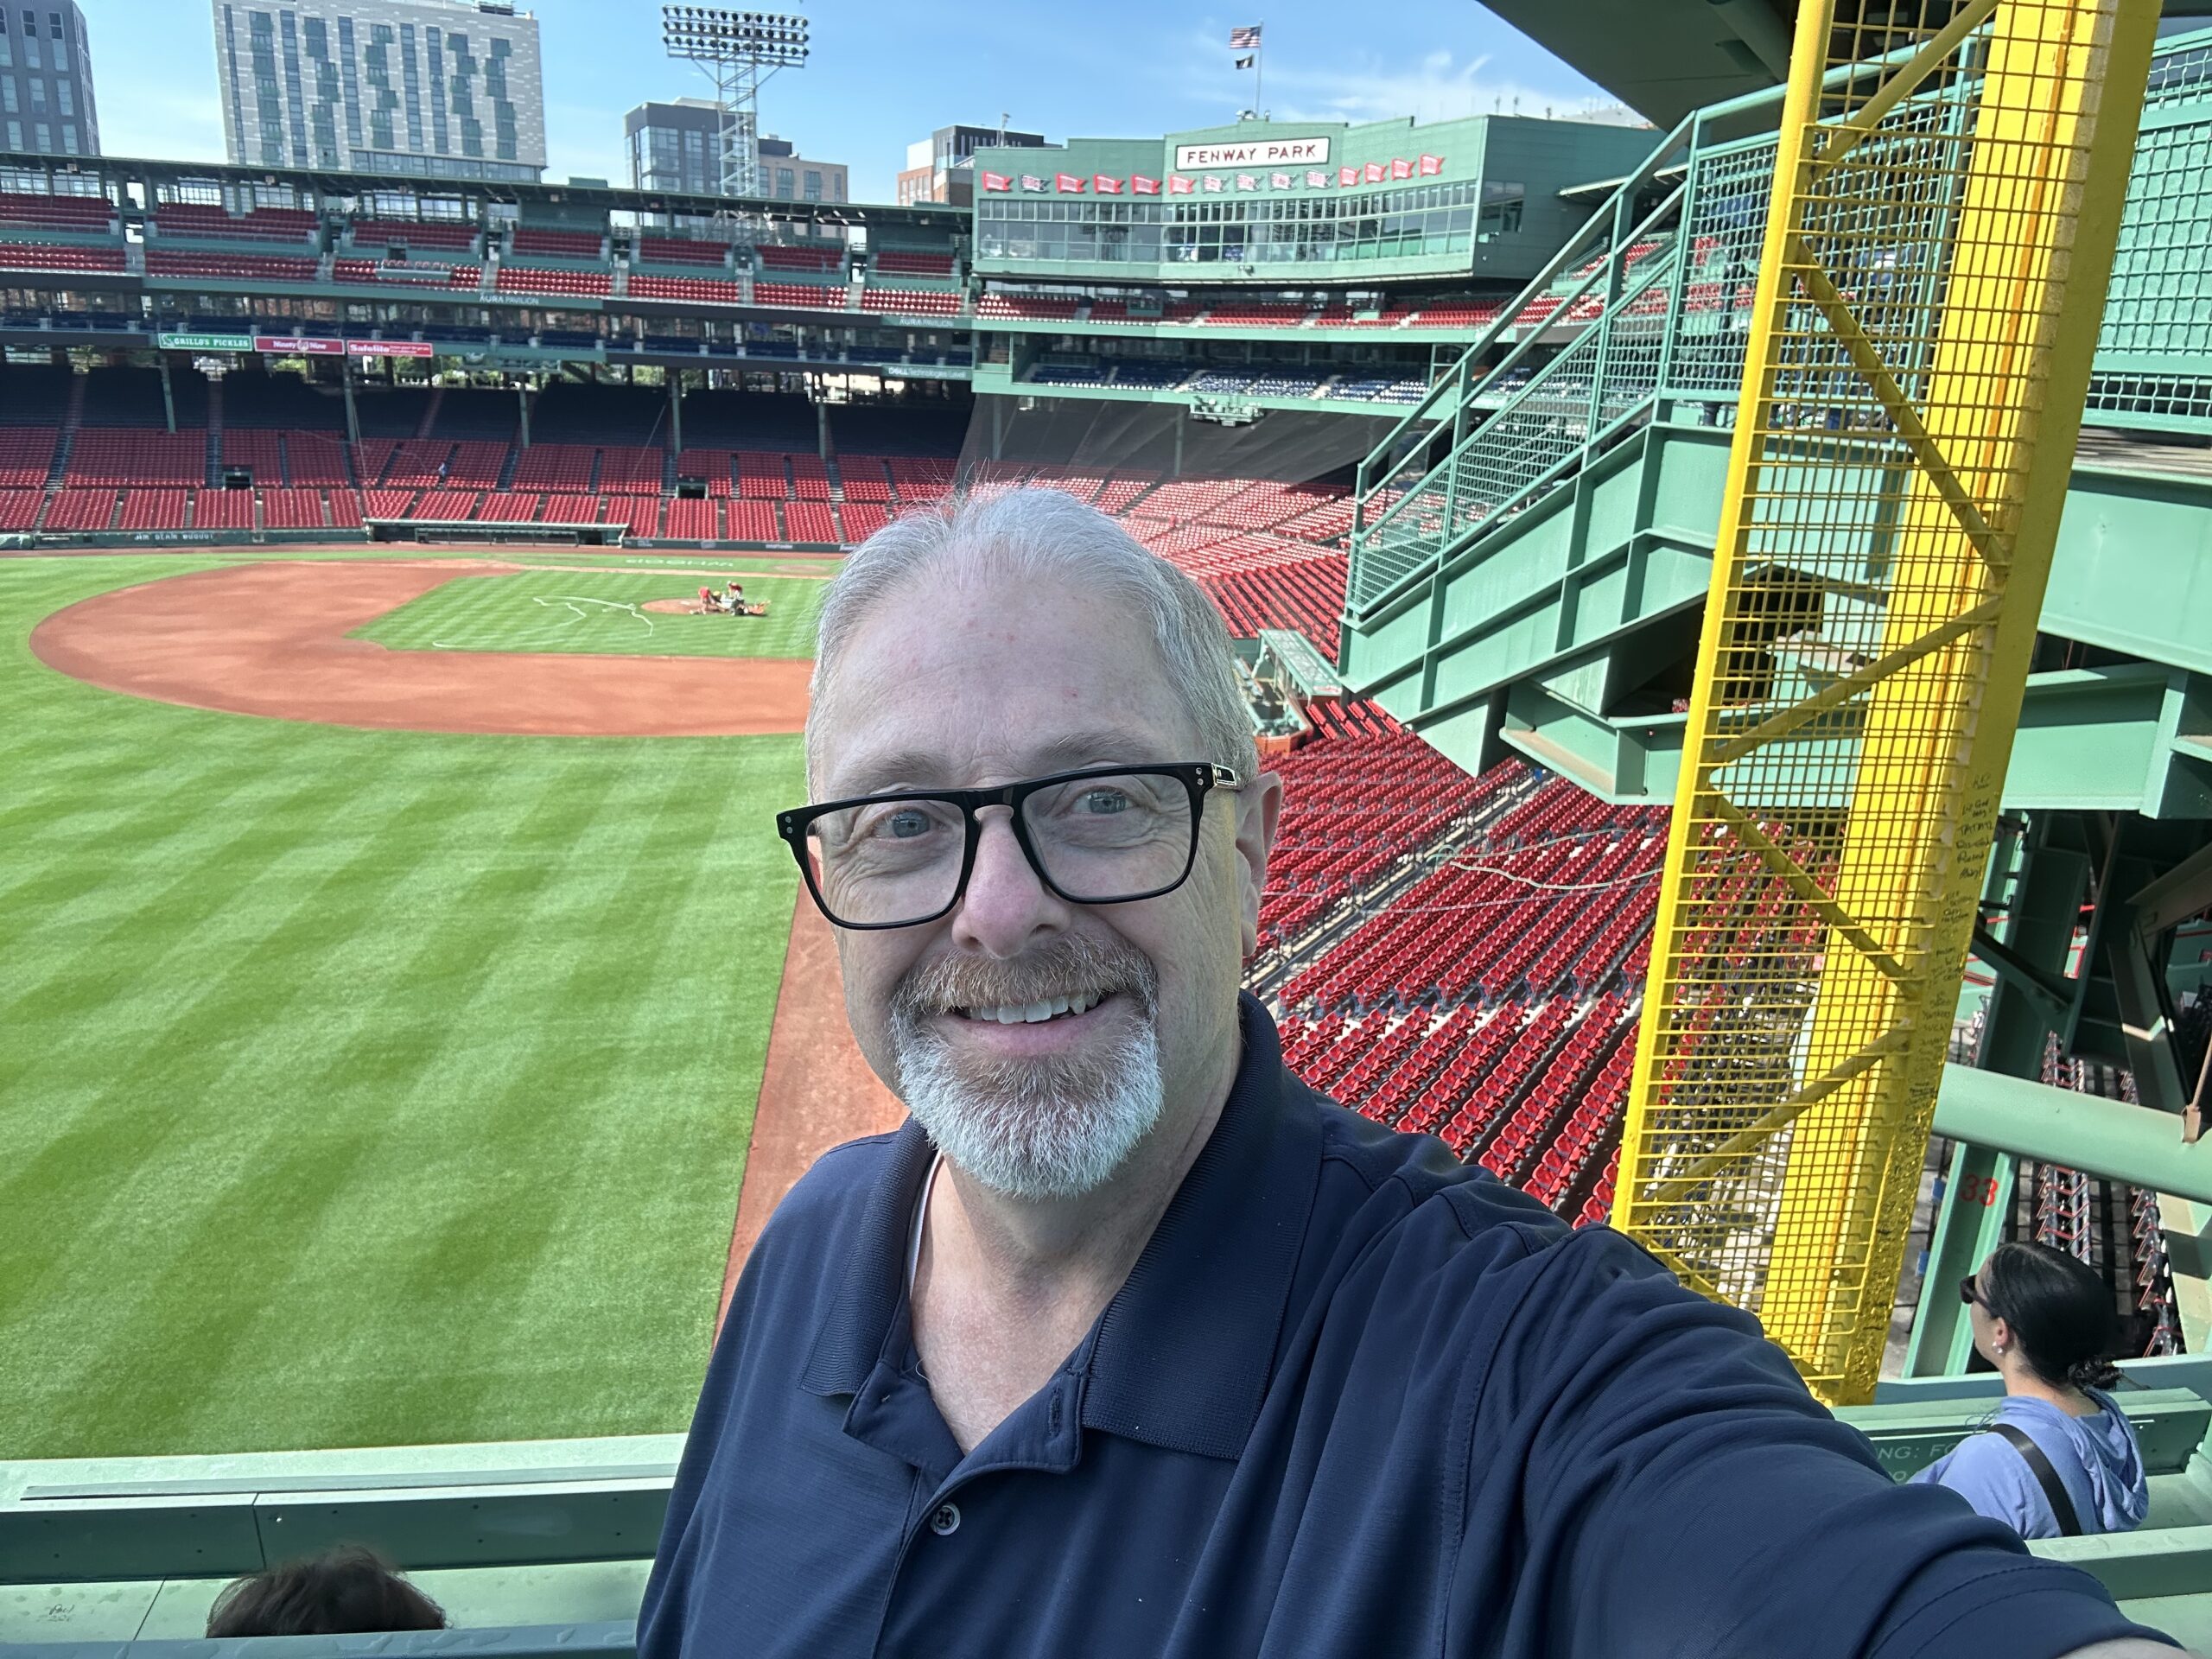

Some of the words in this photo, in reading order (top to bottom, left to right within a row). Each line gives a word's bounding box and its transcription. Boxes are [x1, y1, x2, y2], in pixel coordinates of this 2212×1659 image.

[1187, 148, 1256, 164] FENWAY
[1268, 144, 1316, 159] PARK
[174, 337, 210, 346] GRILLO'S
[350, 344, 390, 353] Safelite
[1960, 1173, 1999, 1207] 33
